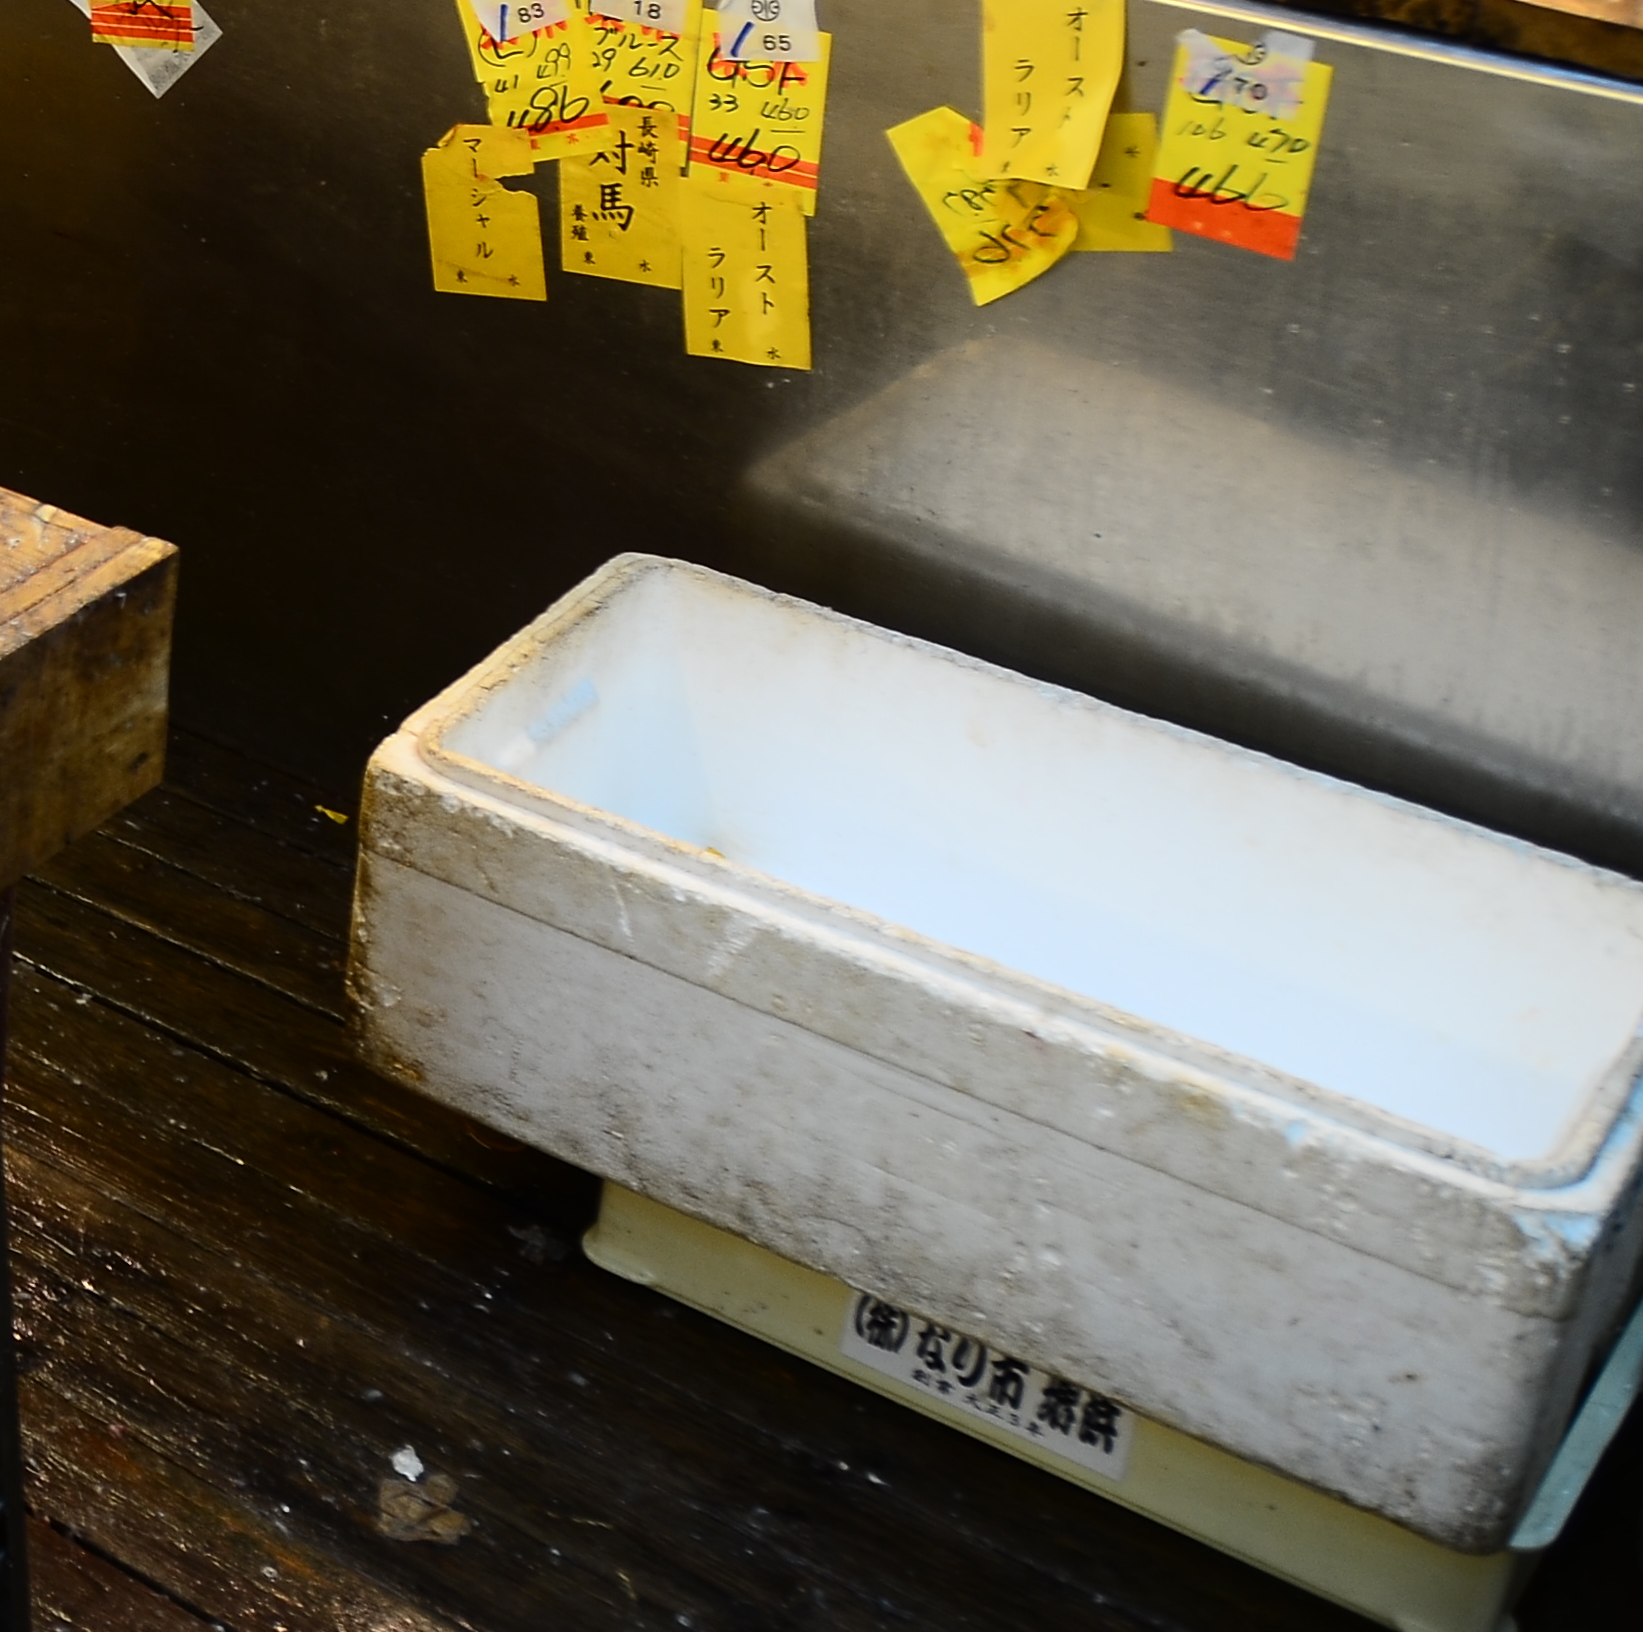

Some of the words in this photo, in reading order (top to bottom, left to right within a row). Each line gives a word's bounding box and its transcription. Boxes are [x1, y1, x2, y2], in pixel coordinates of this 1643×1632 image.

[517, 2, 546, 24] 83
[633, 0, 662, 20] 18
[762, 34, 793, 51] 65
[1009, 58, 1035, 149] ラリア
[589, 129, 636, 233] 対馬
[637, 116, 661, 188] 長崎県
[462, 138, 495, 260] マーシャル
[570, 203, 591, 242] 養殖
[707, 246, 731, 329] ラリア
[751, 201, 776, 315] オースト
